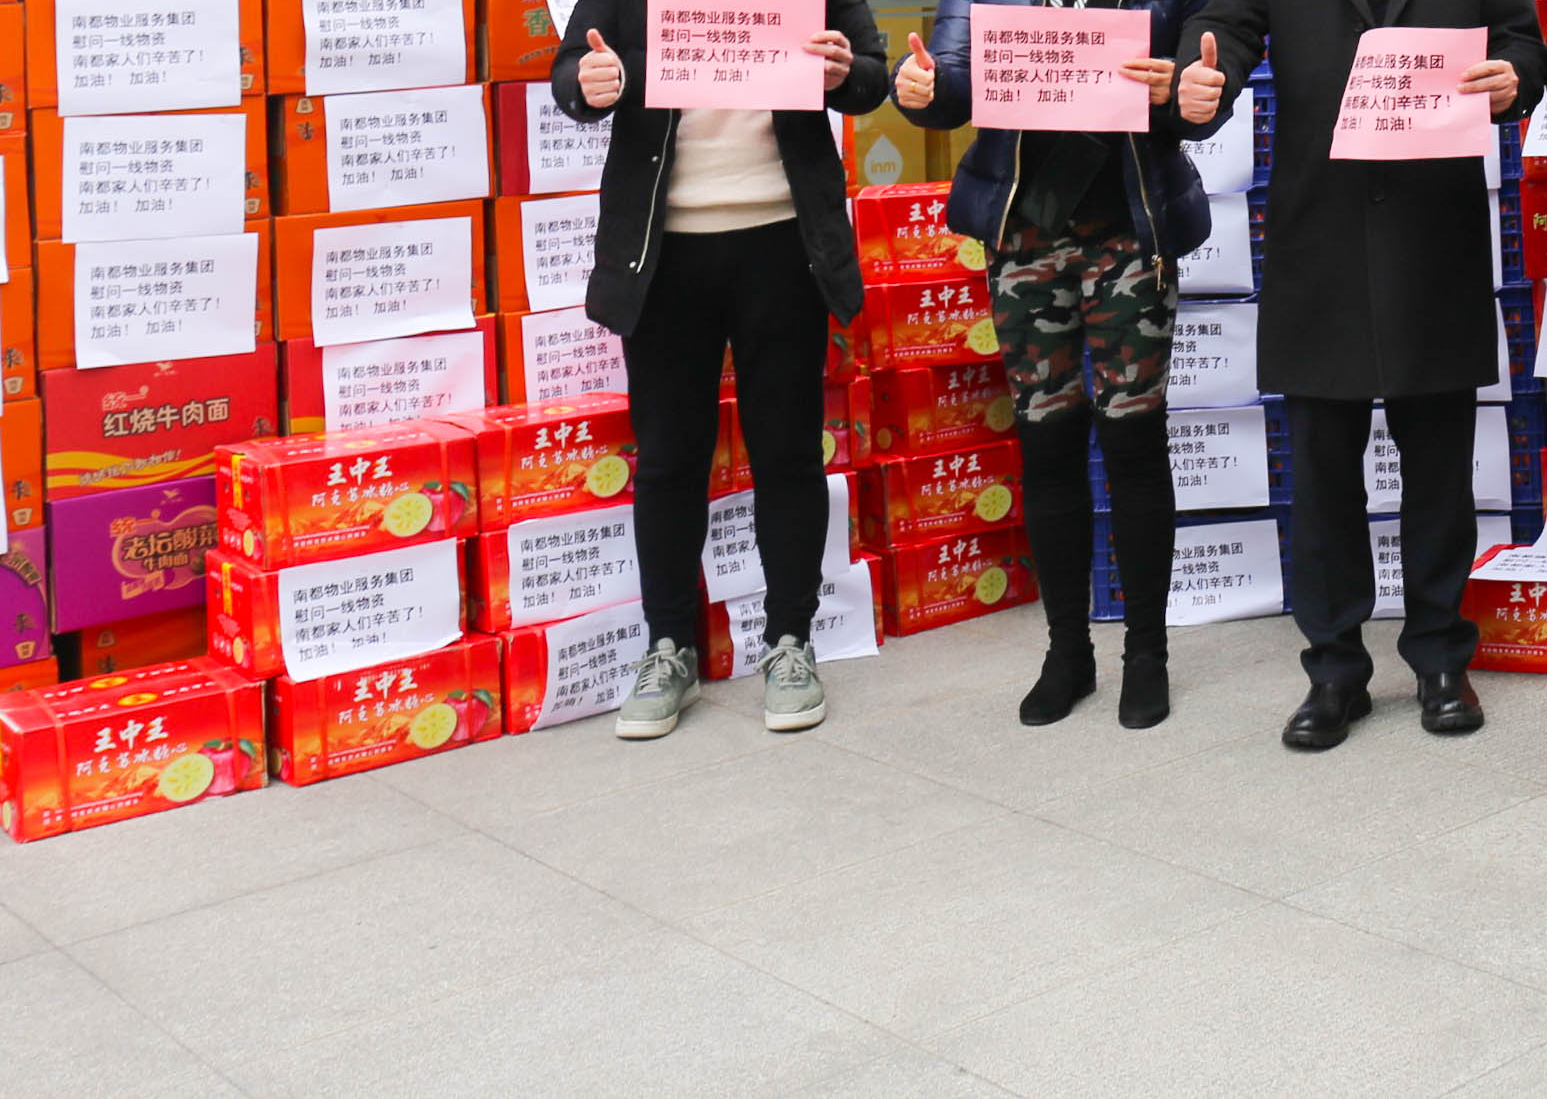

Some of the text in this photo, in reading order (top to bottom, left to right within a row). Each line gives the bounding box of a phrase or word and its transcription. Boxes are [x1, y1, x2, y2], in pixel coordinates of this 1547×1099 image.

[319, 16, 399, 32] 慰问一线物资
[661, 10, 781, 26] 南都物业服务集团
[320, 32, 433, 51] 南都家人们辛苦了！
[661, 28, 751, 44] 慰问一线物资
[984, 30, 1105, 46] 南都物业服务集团
[320, 51, 401, 69] 加油！ 加油！
[661, 47, 787, 64] 南都家人们辛苦了！
[984, 49, 1074, 64] 慰问一线物资
[660, 67, 749, 82] 加油！ 加油！
[984, 68, 1112, 84] 南都家人们辛苦了！
[985, 88, 1073, 102] 加油！ 加油！
[91, 259, 214, 281] 南都物业服务集团
[90, 281, 183, 300] 慰问一线物资
[919, 285, 974, 308] 王中王
[91, 297, 219, 320] 南都家人们辛苦了！
[89, 319, 182, 340] 加油！ 加油！
[947, 365, 991, 390] 王中王
[103, 397, 231, 438] 红烧牛肉面
[534, 421, 593, 450] 王中王
[327, 455, 393, 486] 王中王
[932, 453, 982, 479] 王中王
[122, 521, 217, 561] 老坛酸菜
[937, 537, 982, 564] 王中王
[142, 552, 189, 572] 牛肉面
[293, 568, 413, 604] 南都物业服务集团
[295, 593, 384, 624] 慰问一线物资
[296, 606, 422, 643] 南都家人们辛苦了！
[299, 632, 386, 662] 加油！ 加油！
[353, 668, 418, 702] 王中王
[94, 716, 168, 753] 王中王
